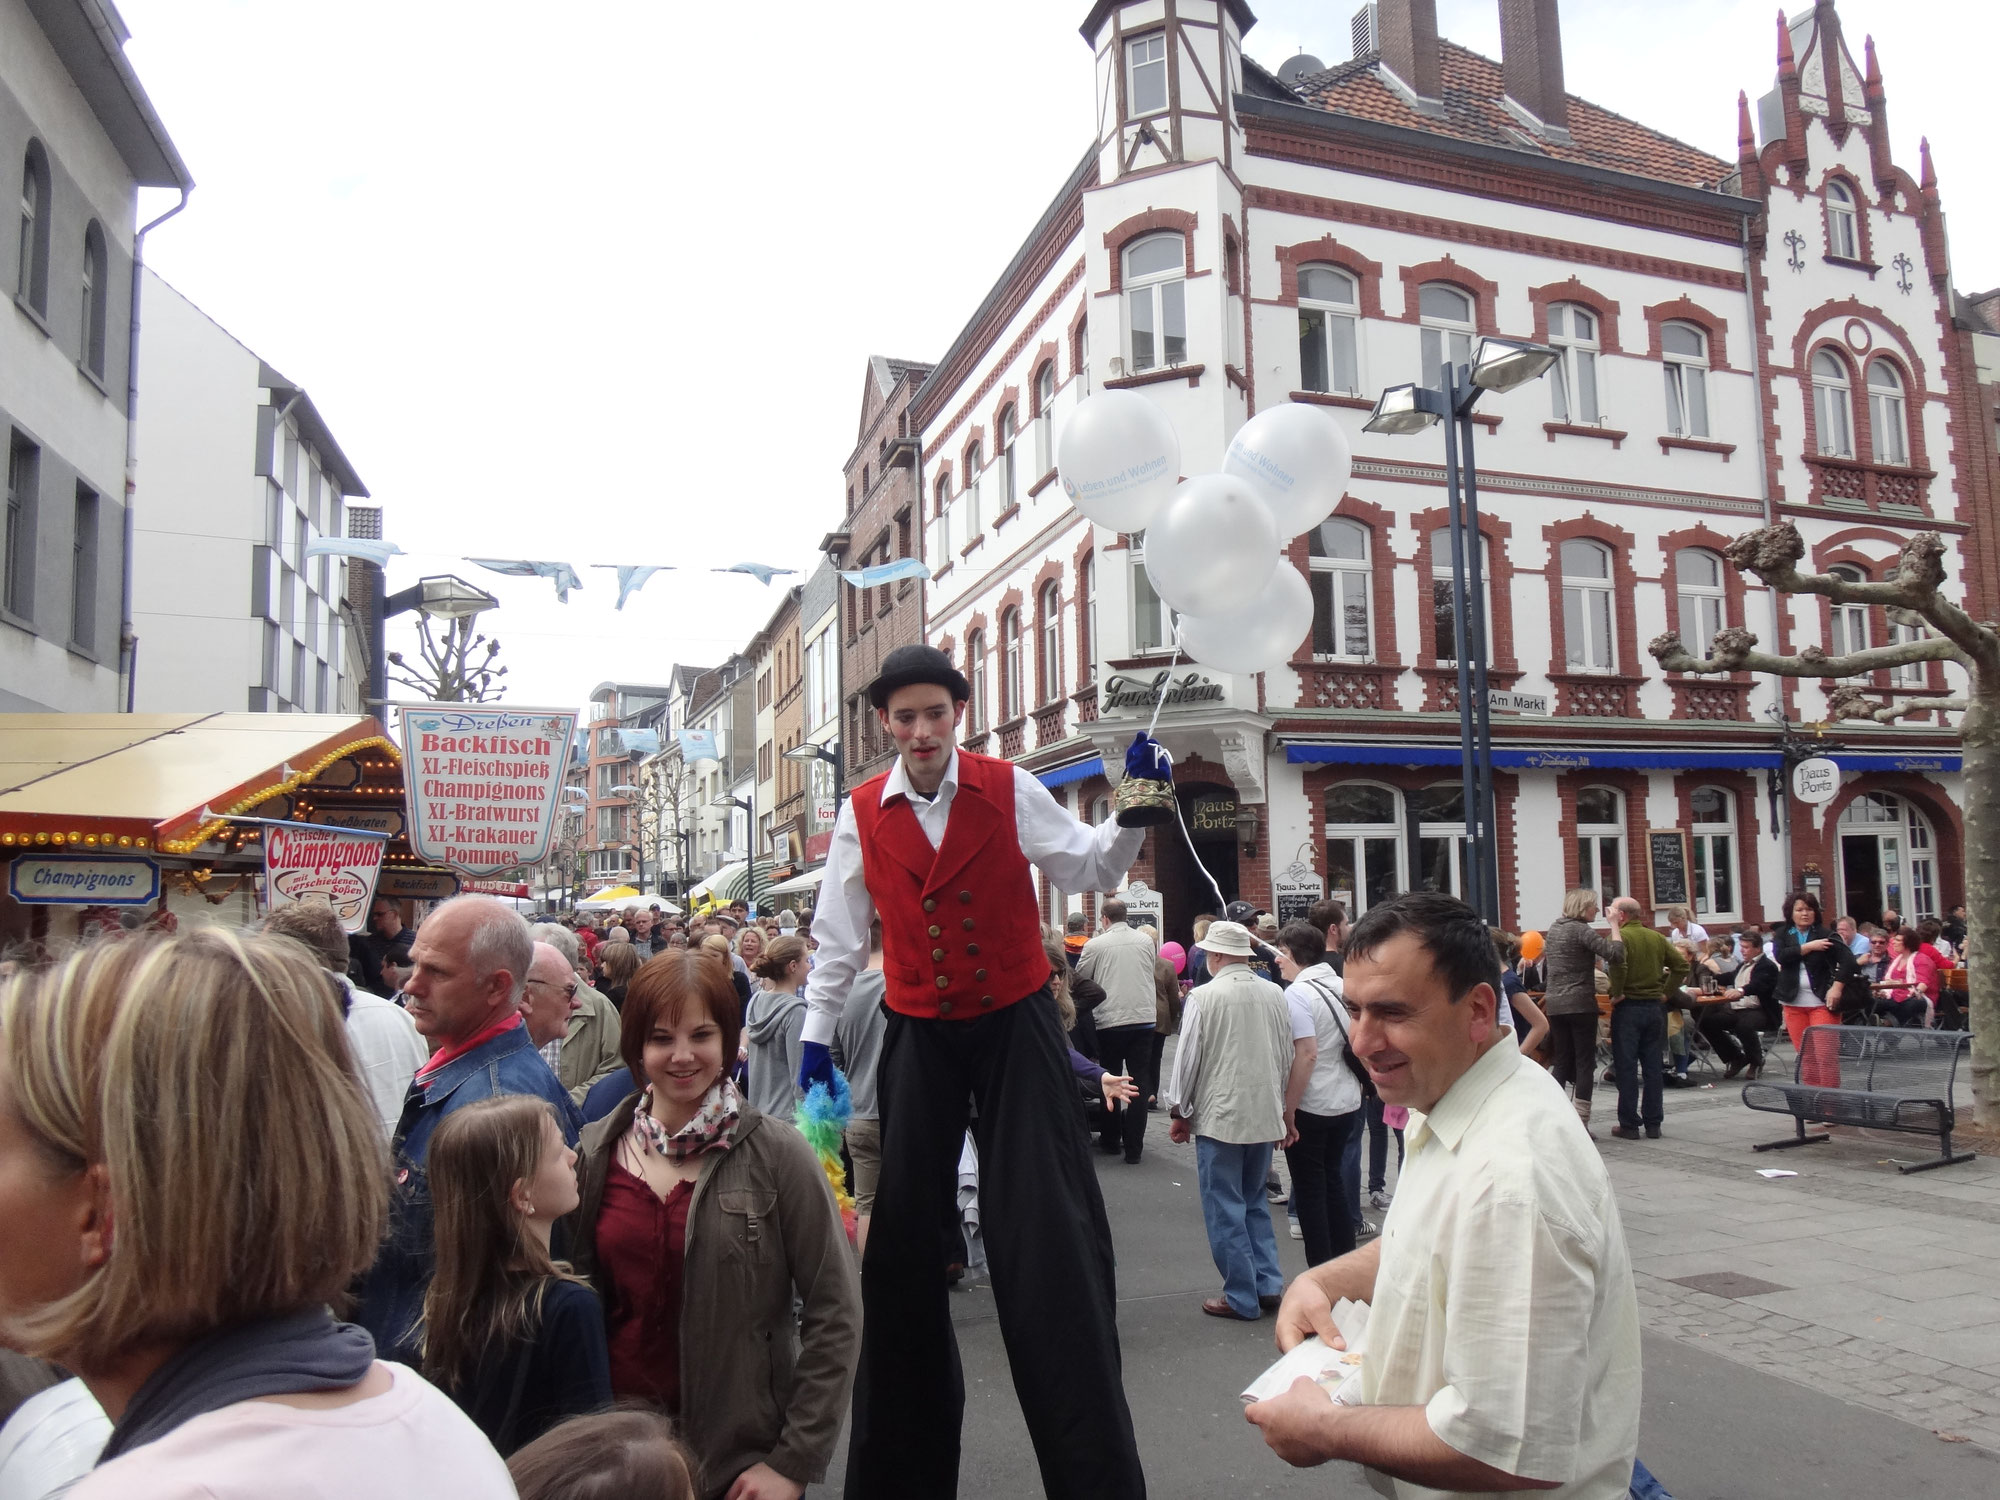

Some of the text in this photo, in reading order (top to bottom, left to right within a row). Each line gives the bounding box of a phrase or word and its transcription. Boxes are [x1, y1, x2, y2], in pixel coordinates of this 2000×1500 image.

[1078, 480, 1105, 492] Leben
[1106, 471, 1127, 487] und
[1128, 455, 1167, 479] Wohnen
[1258, 454, 1295, 486] Wohnen
[1100, 669, 1226, 714] Franknheim
[1489, 693, 1546, 710] Am Markt
[441, 712, 534, 733] Dreßen
[420, 733, 552, 756] Backfisch
[421, 757, 550, 780] XL-Fleischspieß
[423, 779, 546, 802] Champignons
[1800, 780, 1833, 796] Portz
[427, 802, 541, 823] XL-Bratwurst
[1192, 813, 1237, 830] Portz
[291, 829, 331, 842] Frische
[427, 824, 538, 845] XL-Krakauer
[1466, 833, 1474, 843] 10
[267, 827, 383, 876] Champignons
[444, 846, 520, 866] Pommes
[33, 868, 136, 891] Champignons
[285, 876, 359, 895] verschiedenen
[293, 873, 308, 884] mit
[1299, 883, 1321, 891] Portz
[331, 884, 362, 895] Soßen
[1139, 900, 1160, 909] Portz
